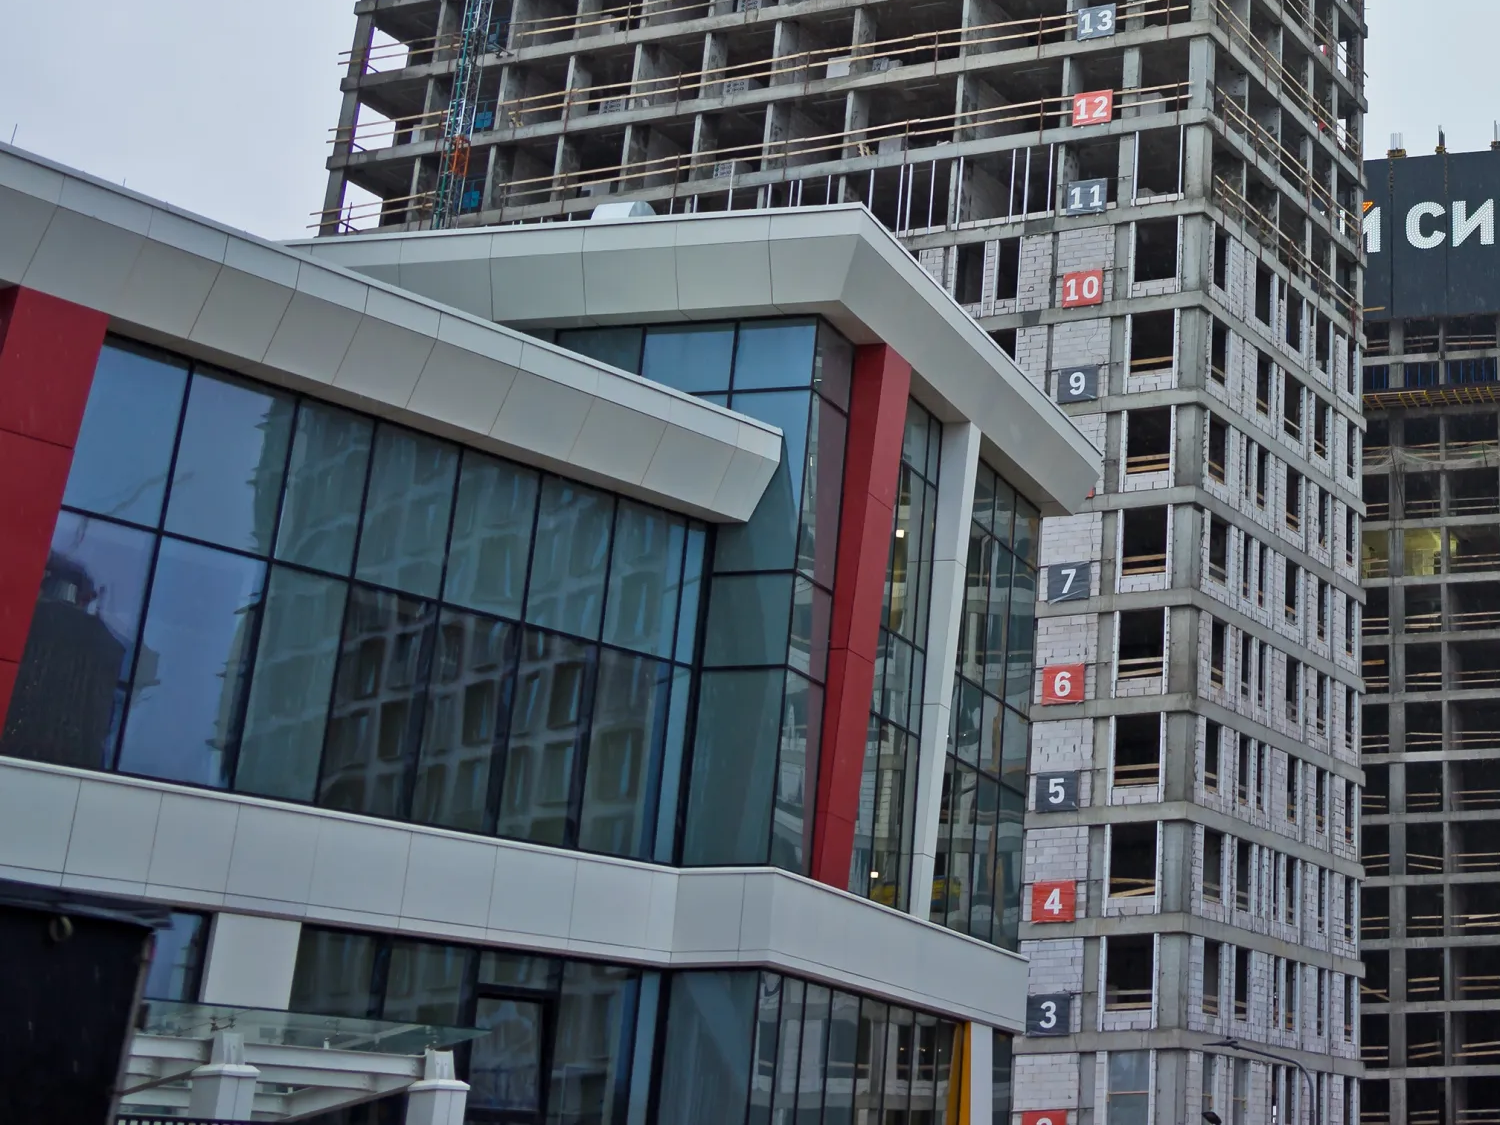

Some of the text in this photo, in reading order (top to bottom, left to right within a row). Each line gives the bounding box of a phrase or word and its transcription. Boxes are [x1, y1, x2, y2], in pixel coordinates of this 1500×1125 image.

[1081, 10, 1113, 35] 13
[1075, 97, 1108, 121] 12
[1070, 185, 1102, 210] 11
[1066, 276, 1099, 301] 10
[1070, 371, 1085, 395] 9
[1060, 569, 1077, 593] 7
[1054, 671, 1071, 696] 6
[1048, 778, 1065, 803] 5
[1044, 888, 1062, 914] 4
[1040, 1001, 1057, 1029] 3
